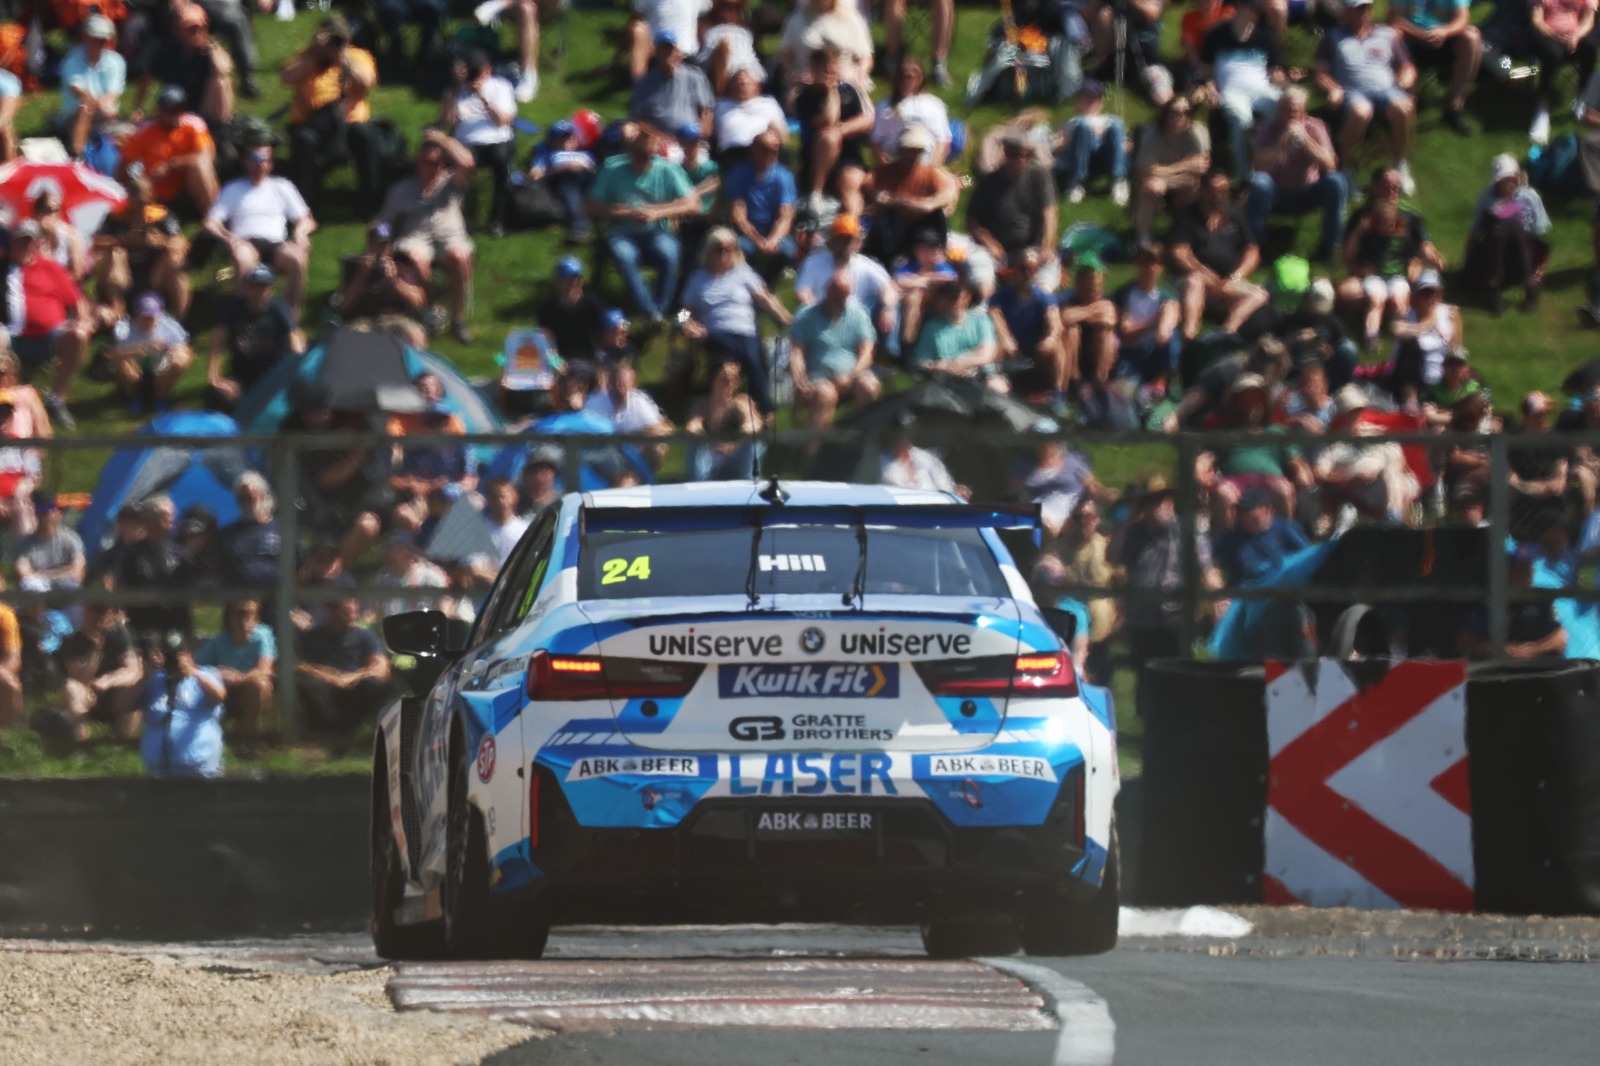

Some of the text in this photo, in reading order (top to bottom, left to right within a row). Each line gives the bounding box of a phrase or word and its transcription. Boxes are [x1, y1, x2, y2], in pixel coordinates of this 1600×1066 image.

[601, 555, 651, 584] 24
[758, 554, 826, 571] Hill
[728, 716, 786, 741] GB
[792, 714, 866, 727] GRATTE
[793, 728, 893, 741] BROTHERS
[480, 740, 494, 776] STP
[580, 758, 693, 777] ABK BEER
[935, 758, 1045, 777] ABK BEER
[729, 752, 898, 795] LASER
[758, 812, 872, 830] ABK BEER
